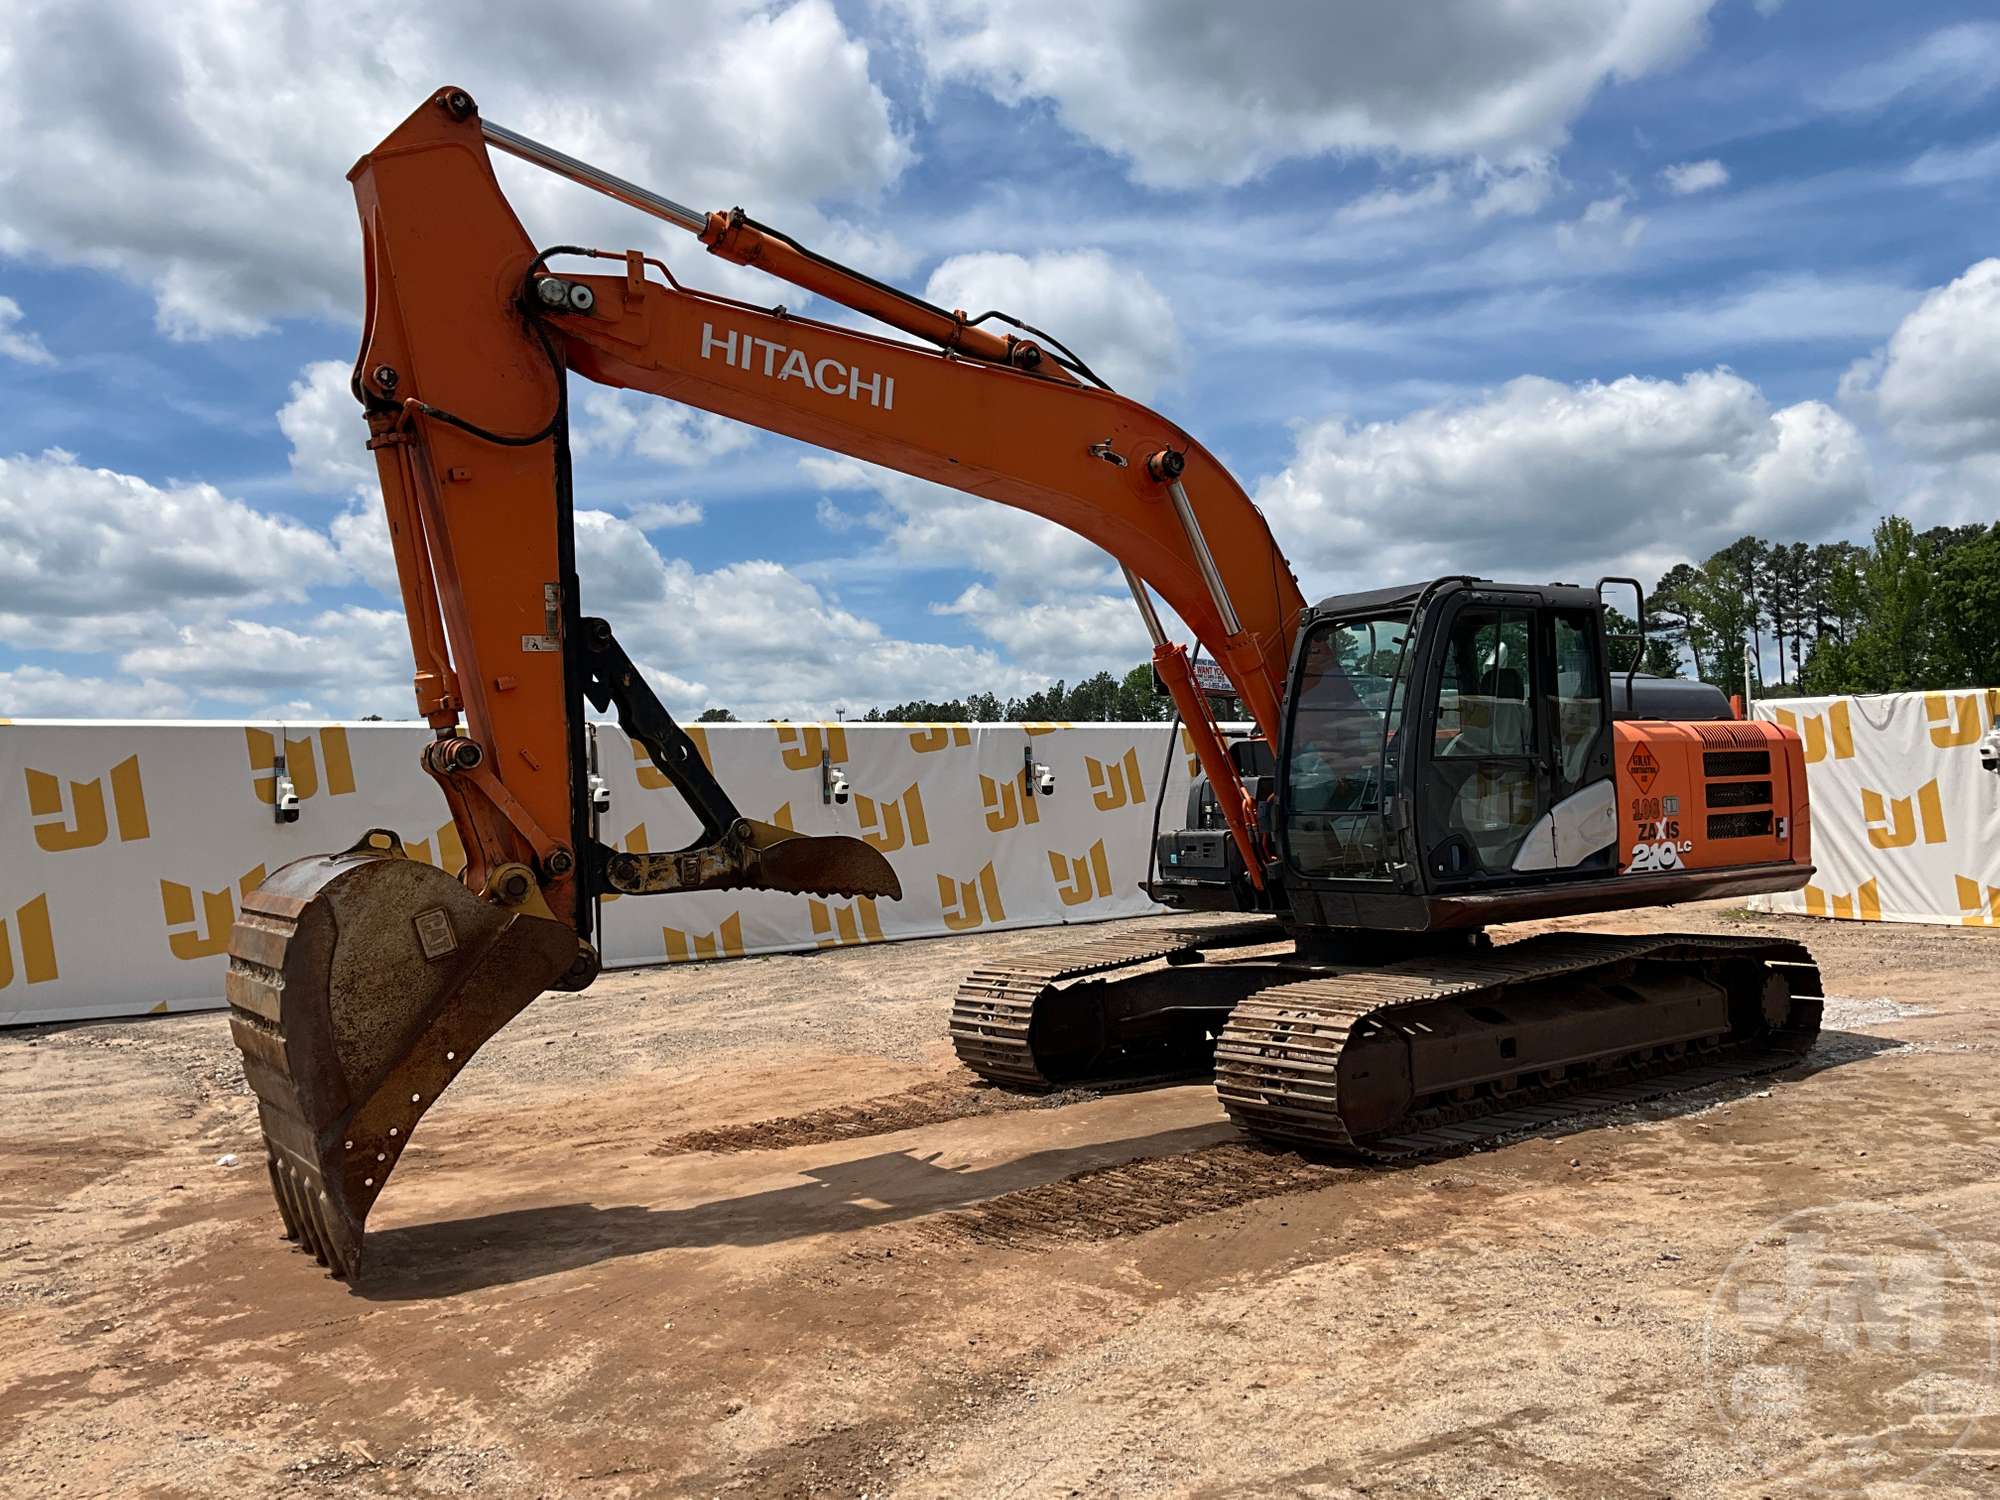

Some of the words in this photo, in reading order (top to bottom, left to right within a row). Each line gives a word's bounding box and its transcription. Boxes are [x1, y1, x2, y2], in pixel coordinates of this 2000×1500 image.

[701, 322, 894, 410] HITACHI
[1638, 817, 1680, 841] ZAXIS
[1632, 842, 1677, 870] 210
